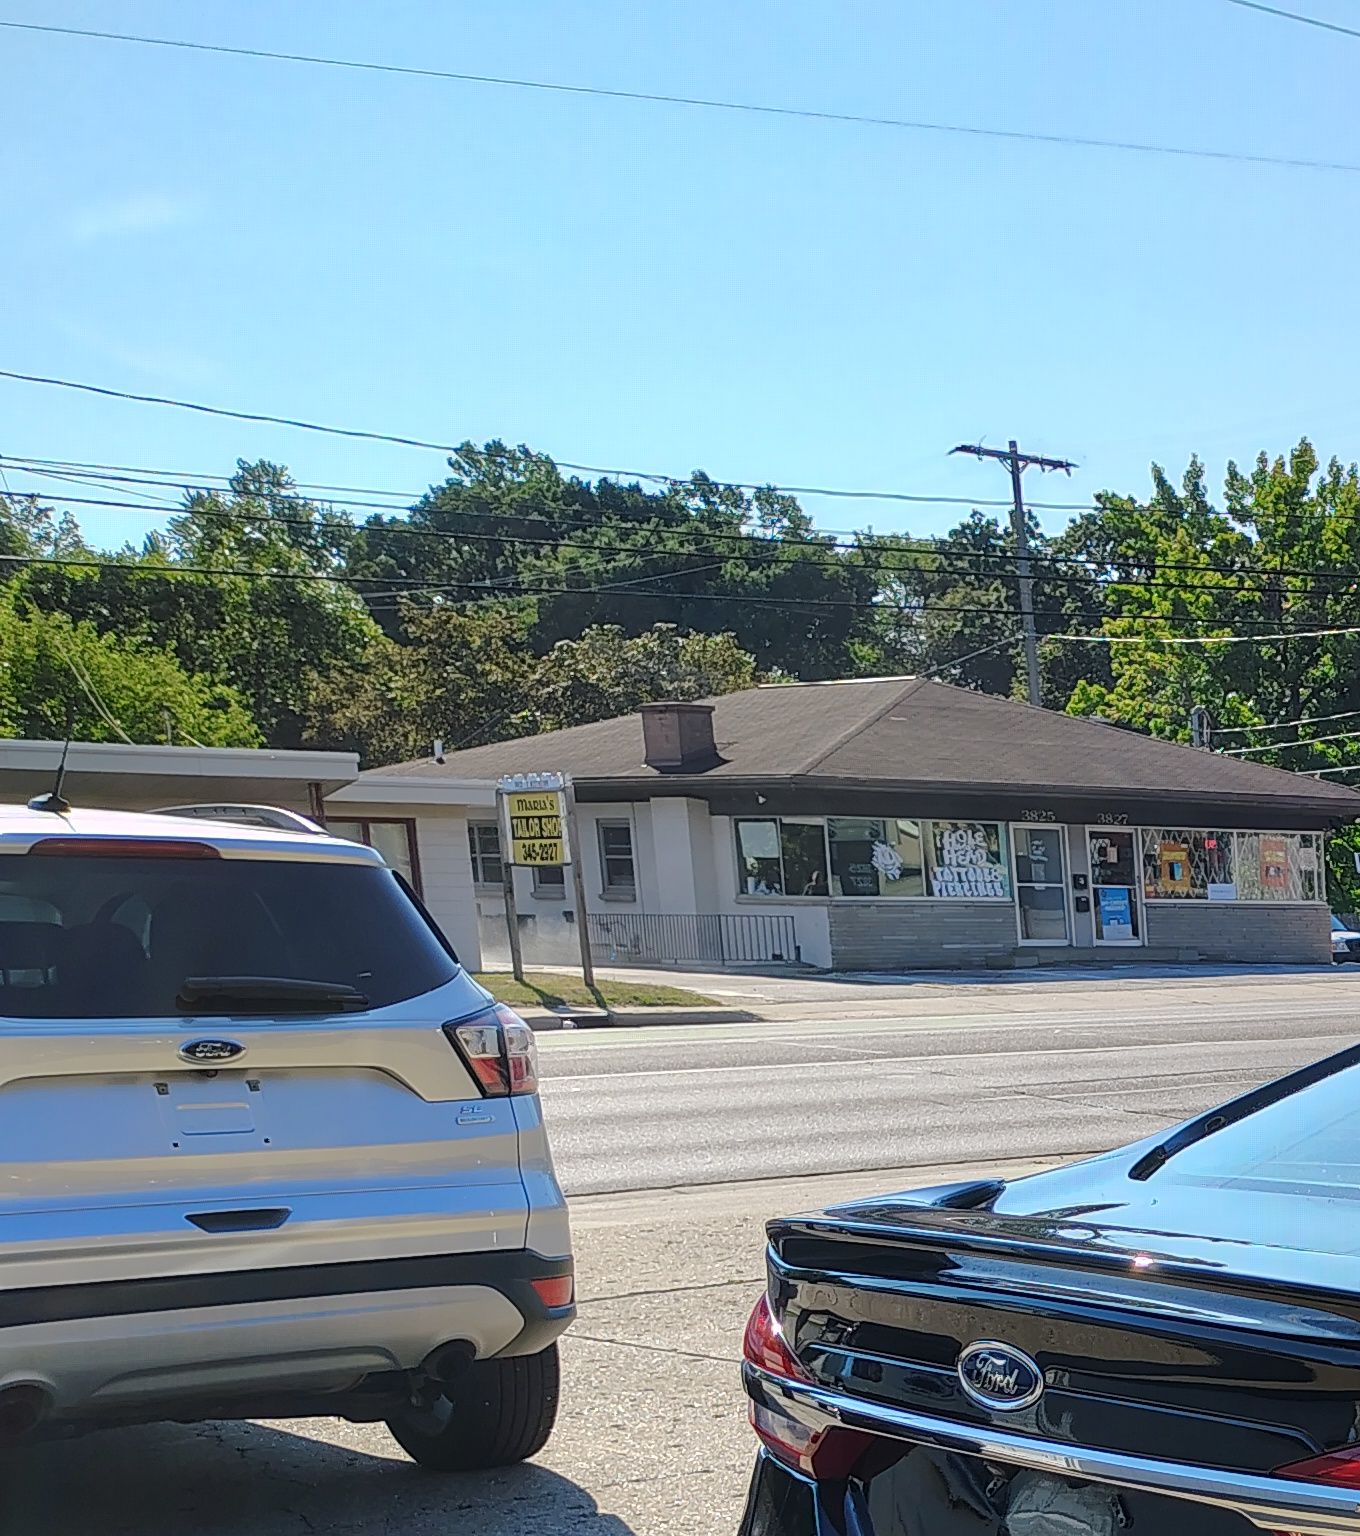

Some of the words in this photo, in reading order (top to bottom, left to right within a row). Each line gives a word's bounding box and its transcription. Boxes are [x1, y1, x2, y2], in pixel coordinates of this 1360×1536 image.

[1021, 809, 1056, 822] 3825
[1097, 813, 1129, 825] 3827
[512, 818, 540, 838] TAILOR
[973, 1353, 1020, 1395] Ford
